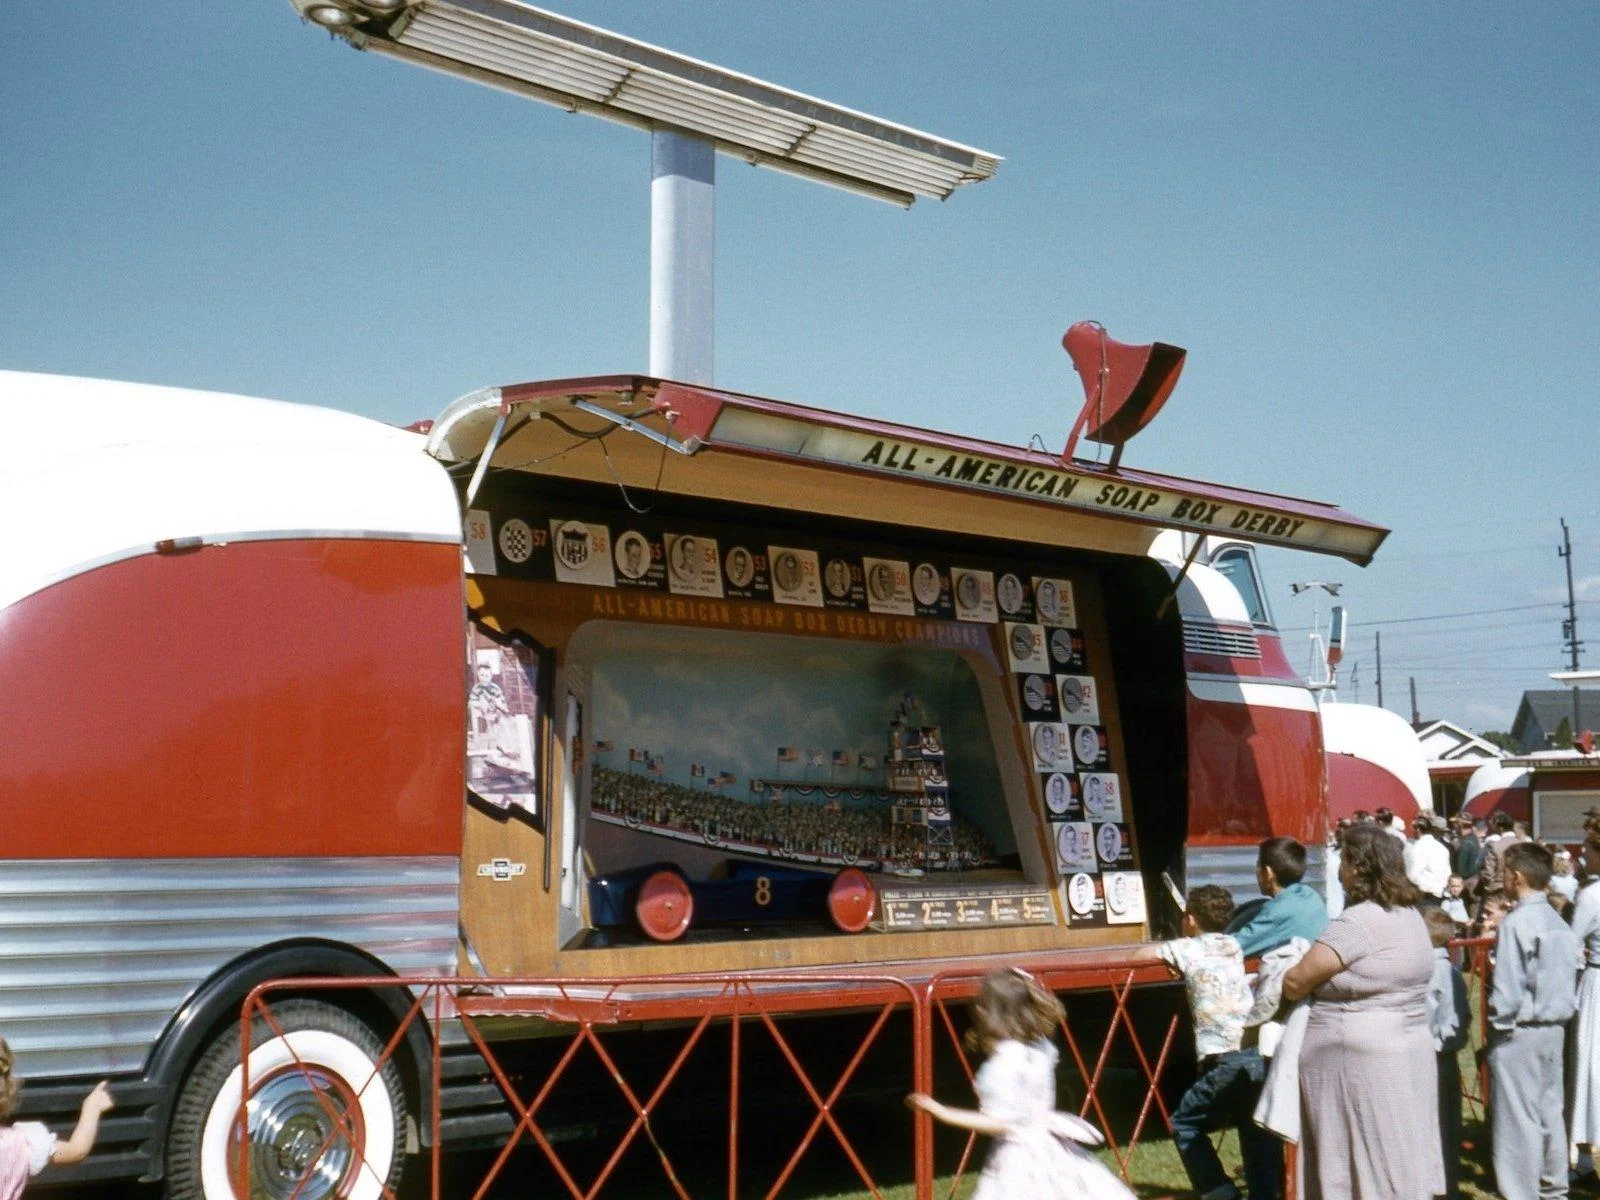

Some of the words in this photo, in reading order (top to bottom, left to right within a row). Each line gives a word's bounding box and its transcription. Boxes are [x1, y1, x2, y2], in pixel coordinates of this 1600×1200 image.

[861, 440, 1080, 499] ALL-AMERICAN
[1094, 483, 1161, 513] SOAP
[1171, 497, 1223, 525] BOX
[1229, 509, 1305, 539] DERBY
[471, 522, 487, 541] 58
[532, 529, 548, 547] 57
[593, 595, 730, 626] ALL-AMERICAN
[739, 606, 786, 630] SOAP
[798, 611, 828, 633] BOX
[837, 614, 887, 637] DERBY
[755, 876, 771, 906] 8
[922, 902, 932, 925] 2
[1022, 897, 1032, 919] 5
